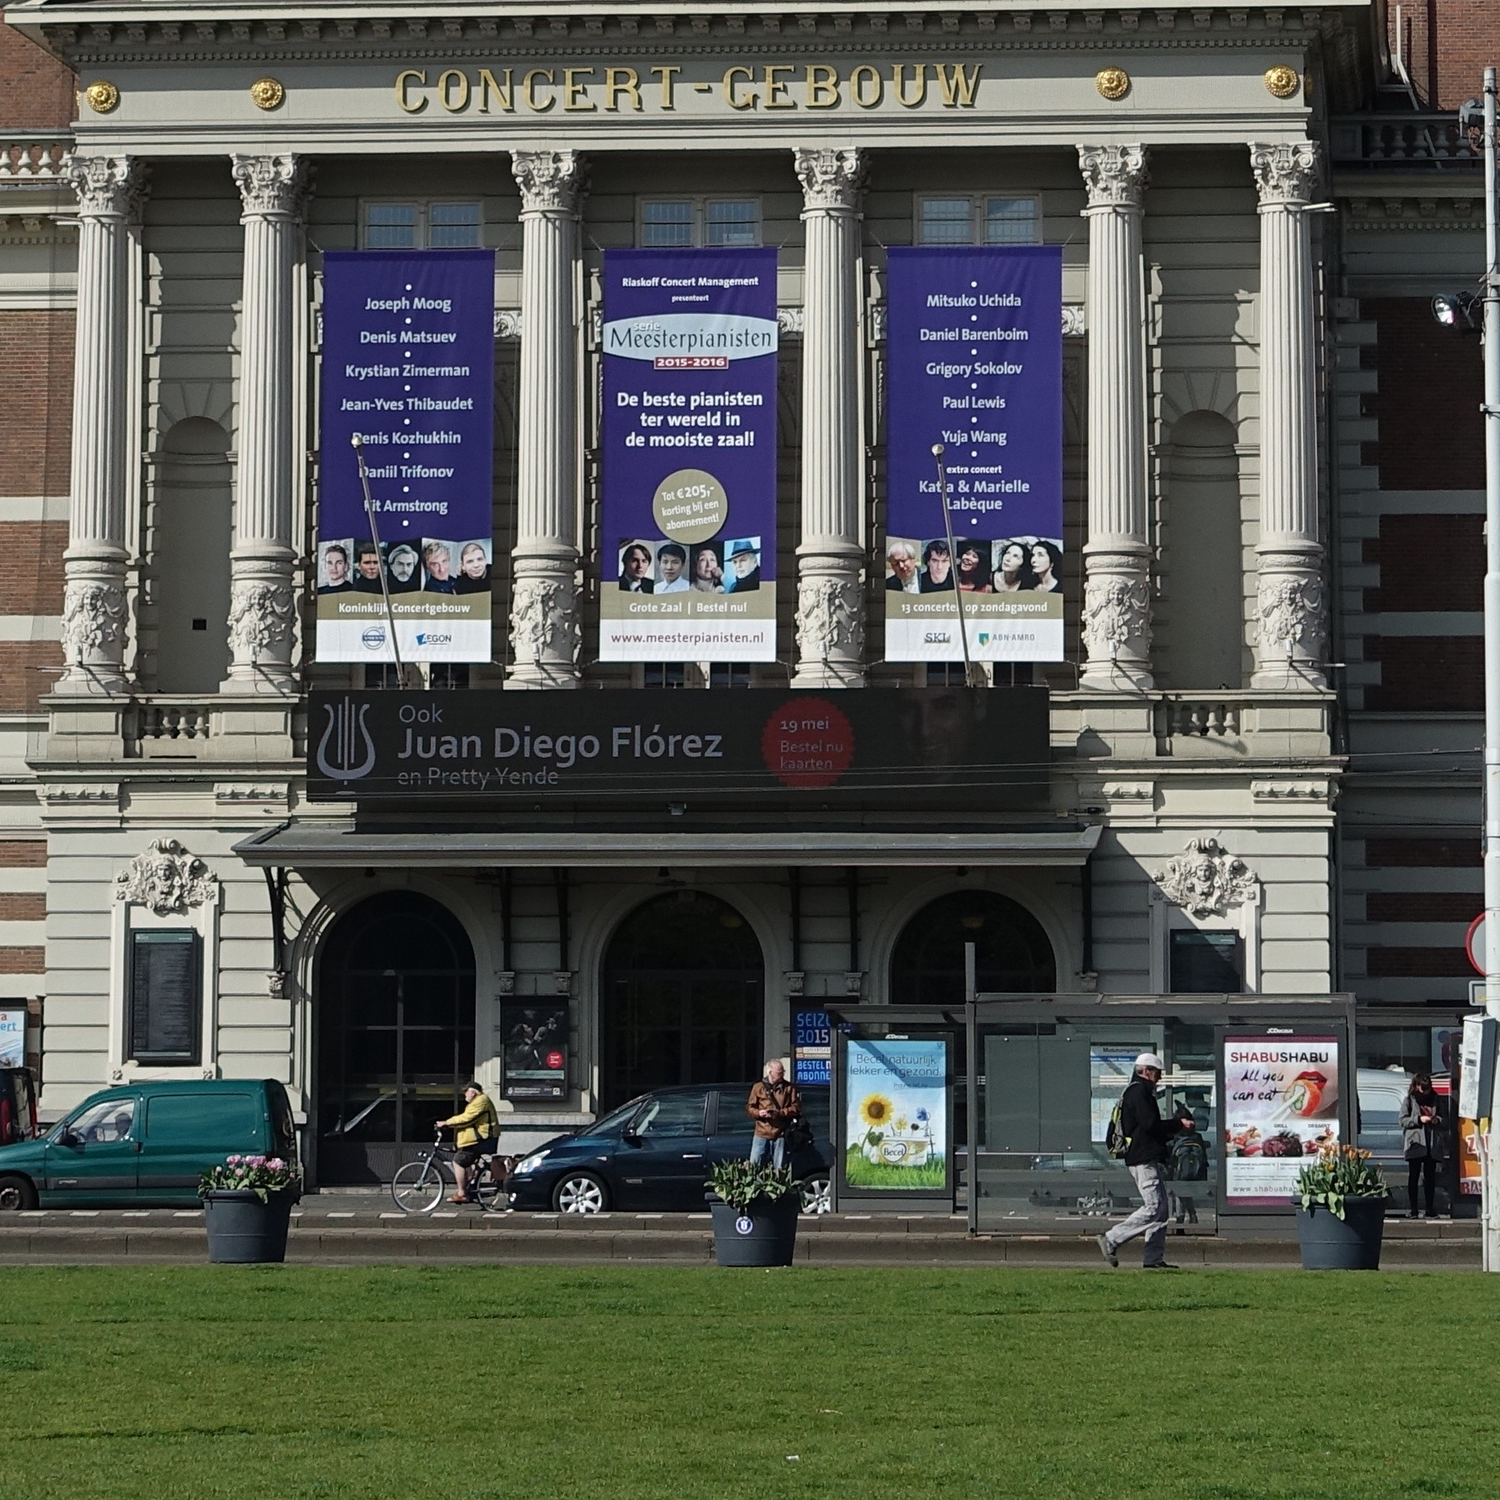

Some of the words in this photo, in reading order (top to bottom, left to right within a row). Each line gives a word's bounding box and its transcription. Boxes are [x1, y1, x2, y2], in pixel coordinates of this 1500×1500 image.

[394, 63, 983, 113] CONCERT-GEBOUW
[622, 277, 660, 287] Riaskoff
[661, 277, 696, 287] Concert
[698, 277, 759, 288] Management
[365, 297, 409, 313] Joseph
[413, 298, 451, 313] Moog
[671, 294, 709, 303] presenteert
[926, 294, 977, 307] Mitsuko
[979, 293, 1021, 307] Uchida
[633, 320, 661, 332] serie
[360, 331, 396, 343] Denis
[400, 331, 456, 343] Matsuev
[610, 327, 772, 353] Meesterpianisten
[920, 328, 959, 341] Daniel
[961, 328, 1029, 341] Barenboim
[657, 358, 725, 367] 2015-2016
[346, 364, 399, 380] Krystian
[403, 364, 469, 376] Zimerman
[926, 362, 972, 378] Grigory
[974, 361, 1023, 375] Sokolov
[341, 399, 404, 411] Jean-Yves
[406, 398, 473, 410] Thibaudet
[617, 392, 638, 407] De
[643, 391, 686, 407] beste
[690, 391, 763, 411] pianisten
[943, 396, 969, 409] Paul
[972, 396, 1006, 409] Lewis
[640, 412, 663, 427] ter
[667, 411, 721, 427] wereld
[725, 411, 740, 426] in
[392, 431, 461, 444] Kozhukhin
[625, 432, 645, 447] de
[649, 432, 714, 447] mooiste
[717, 431, 755, 447] zaal!
[941, 430, 968, 446] Yuja
[970, 430, 1007, 446] Wang
[359, 465, 397, 478] Daniil
[400, 465, 454, 478] Trifonov
[946, 465, 969, 474] extra
[970, 465, 1002, 474] concert
[919, 480, 954, 493] Kata
[957, 480, 970, 493] &
[973, 479, 1030, 493] Marielle
[661, 491, 675, 502] Tot
[384, 500, 448, 515] Armstrong
[661, 504, 691, 517] korting
[692, 502, 703, 514] bij
[704, 501, 719, 510] een
[947, 497, 1003, 513] Labèque
[666, 512, 719, 531] abonnement!
[339, 603, 388, 615] Koninklijk
[392, 603, 470, 615] Concertgebouw
[629, 602, 658, 613] Grote
[660, 602, 682, 613] Zaal
[696, 602, 727, 613] Bestel
[730, 602, 747, 613] nu!
[901, 603, 911, 614] 13
[913, 602, 959, 613] concerte
[965, 604, 978, 615] op
[980, 602, 1048, 614] zondagavond
[611, 632, 764, 646] www.meesterpianisten.nl
[399, 703, 443, 723] Ook
[780, 720, 798, 733] 19
[802, 716, 829, 730] mei
[398, 728, 482, 759] Juan
[494, 725, 600, 768] Diego
[611, 723, 723, 759] Flórez
[780, 740, 822, 753] Bestel
[826, 744, 843, 753] nu
[780, 756, 833, 770] kaarten
[398, 772, 421, 785] en
[428, 767, 490, 791] Pretty
[494, 766, 559, 785] Yende
[857, 1054, 885, 1064] Becel
[889, 1054, 936, 1067] natuurlijk
[1230, 1052, 1329, 1063] SHABUSHABU
[797, 1061, 825, 1070] BESTEL
[850, 1066, 881, 1075] lekker
[900, 1067, 942, 1078] gezond.
[798, 1071, 831, 1080] ABONNE
[1241, 1069, 1259, 1081] All
[1263, 1071, 1285, 1086] you
[1232, 1091, 1254, 1100] can
[1258, 1087, 1285, 1100] eat
[884, 1148, 904, 1156] Becel
